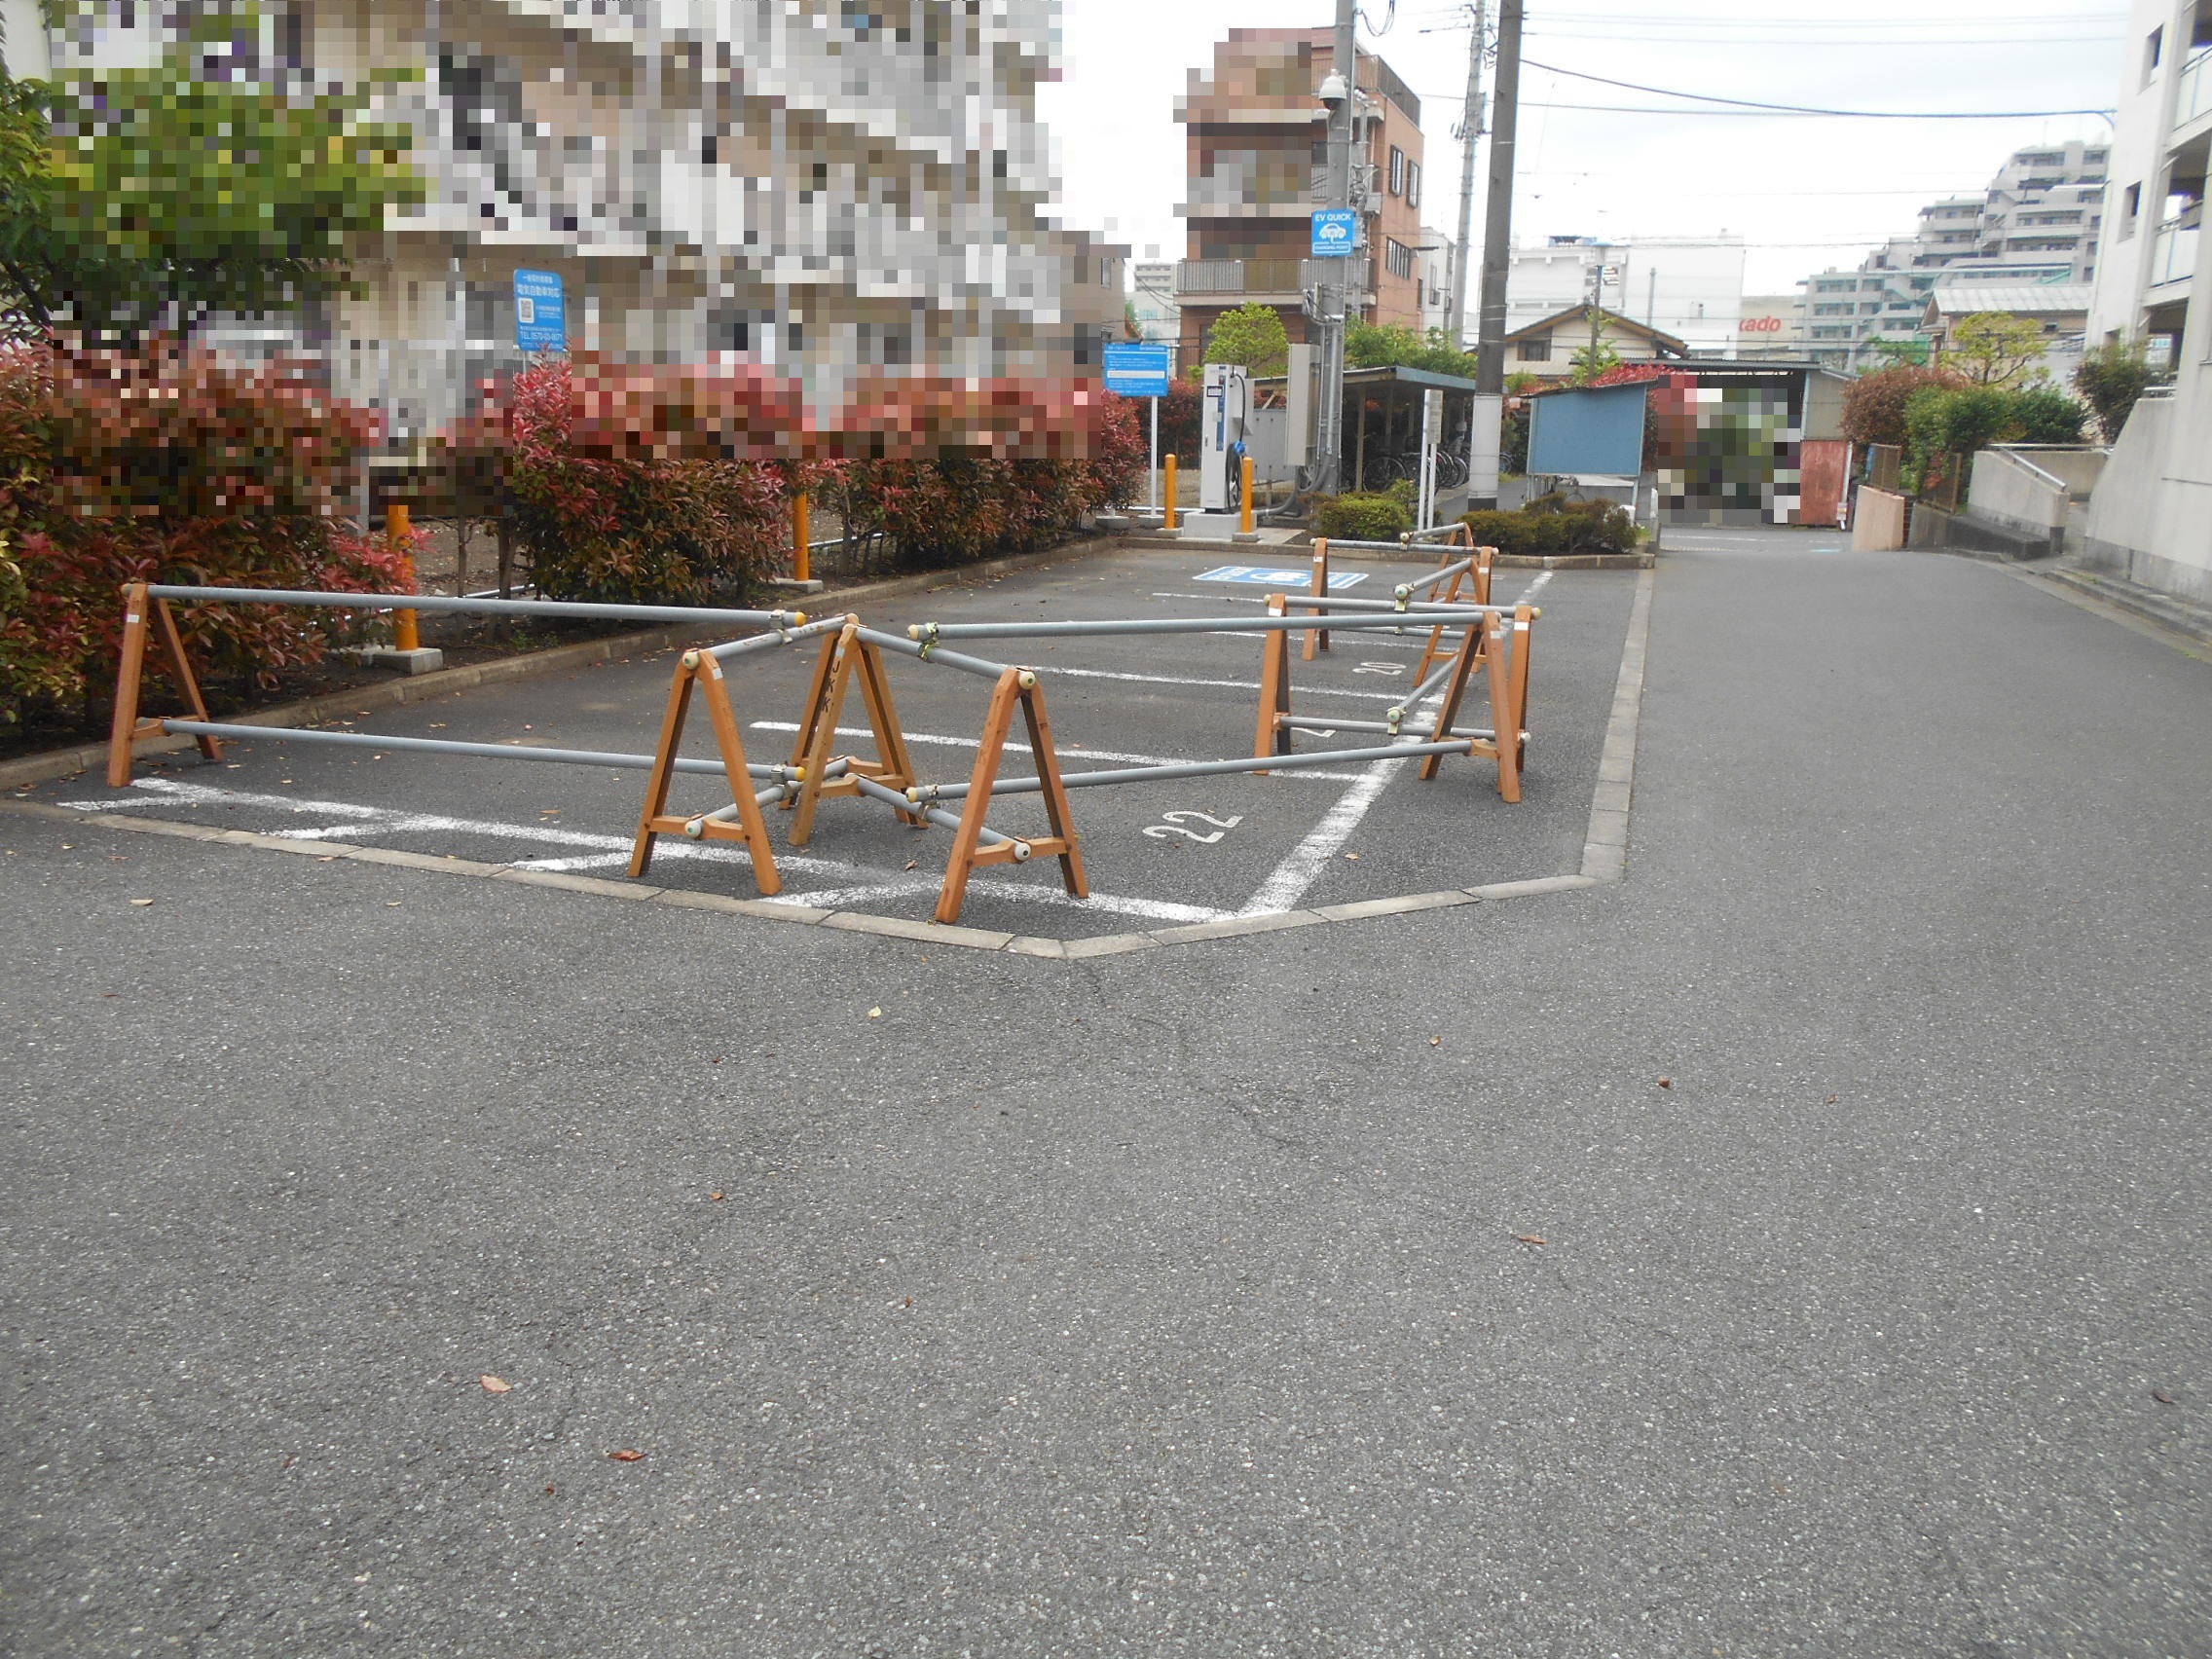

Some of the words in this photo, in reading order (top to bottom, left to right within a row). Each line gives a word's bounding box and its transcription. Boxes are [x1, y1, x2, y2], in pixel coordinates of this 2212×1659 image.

[1314, 213, 1325, 222] EV
[1327, 213, 1351, 222] QUICK
[1352, 662, 1407, 675] 20
[1142, 810, 1244, 844] 22
